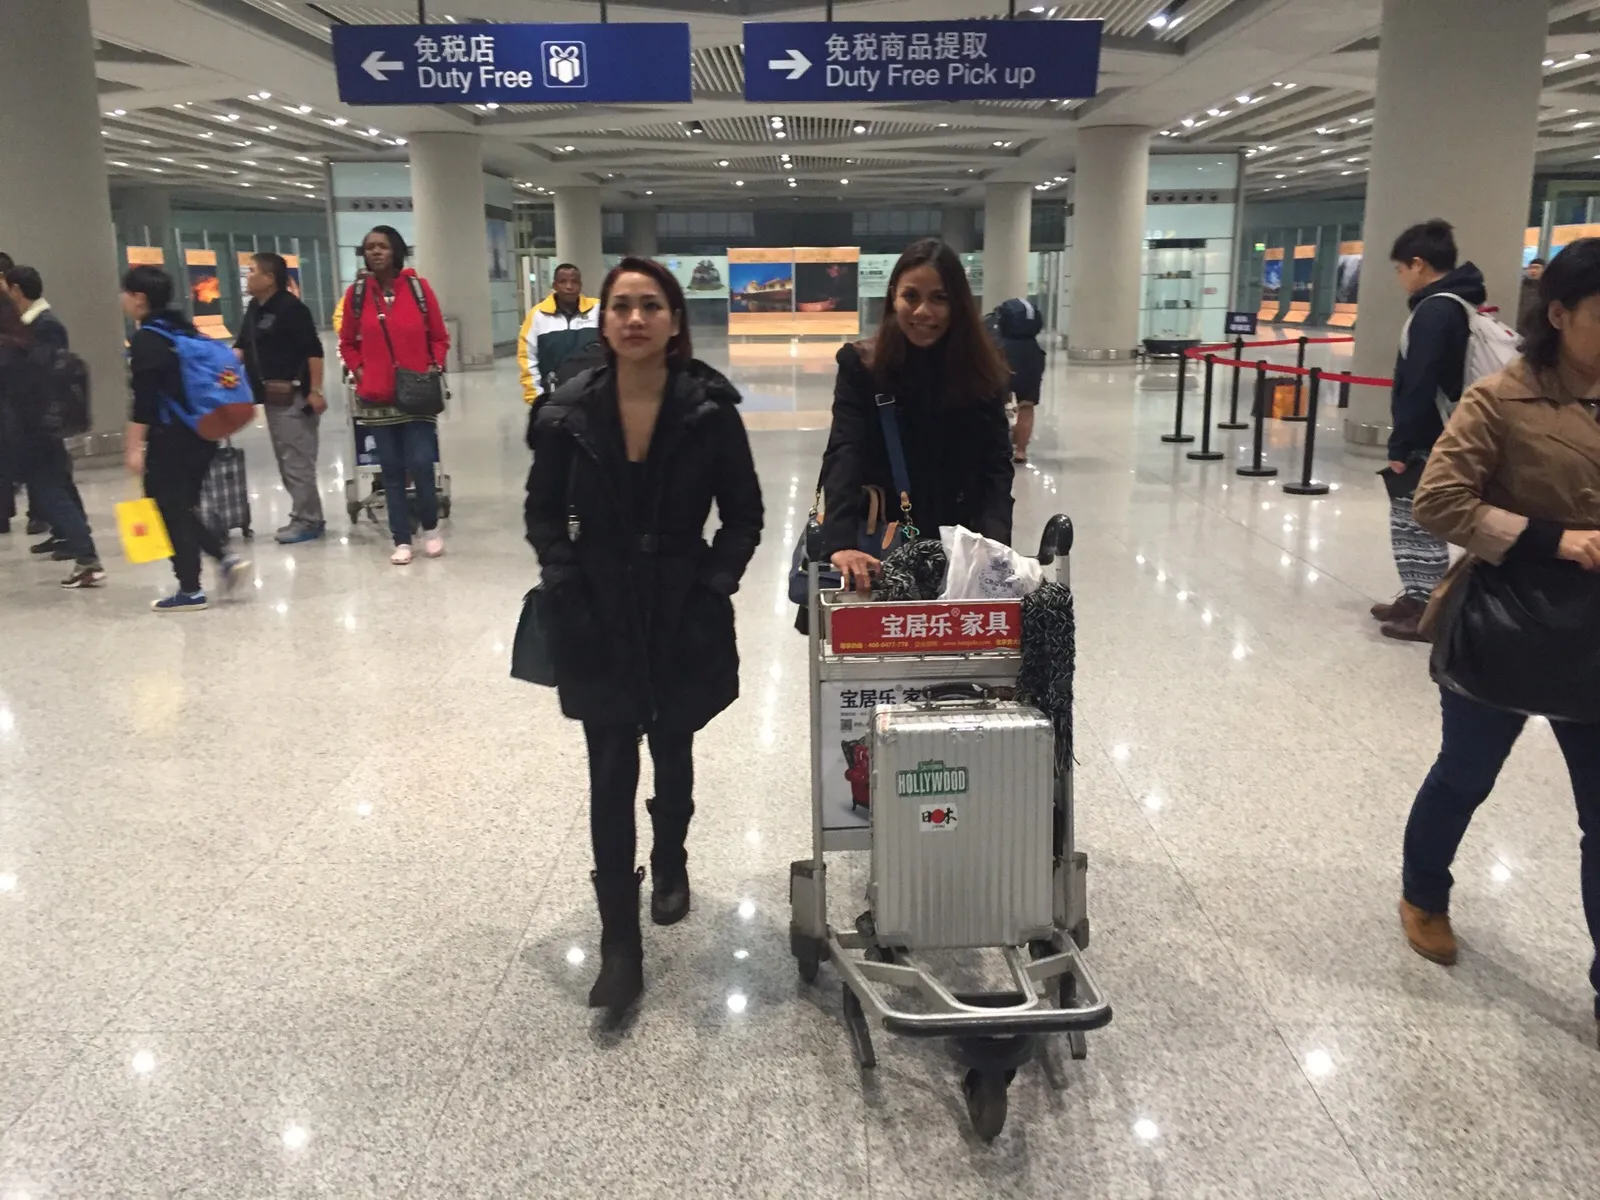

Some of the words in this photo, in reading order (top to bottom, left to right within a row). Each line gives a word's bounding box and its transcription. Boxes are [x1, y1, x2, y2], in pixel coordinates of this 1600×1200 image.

[414, 34, 495, 64] 免税店
[824, 31, 988, 62] 免税商品提取
[418, 66, 473, 94] Duty
[479, 65, 534, 89] Free
[825, 65, 881, 92] Duty
[887, 64, 941, 87] Free
[947, 63, 998, 86] Pick
[1004, 65, 1036, 89] up
[898, 770, 966, 794] HOLLYWOOD
